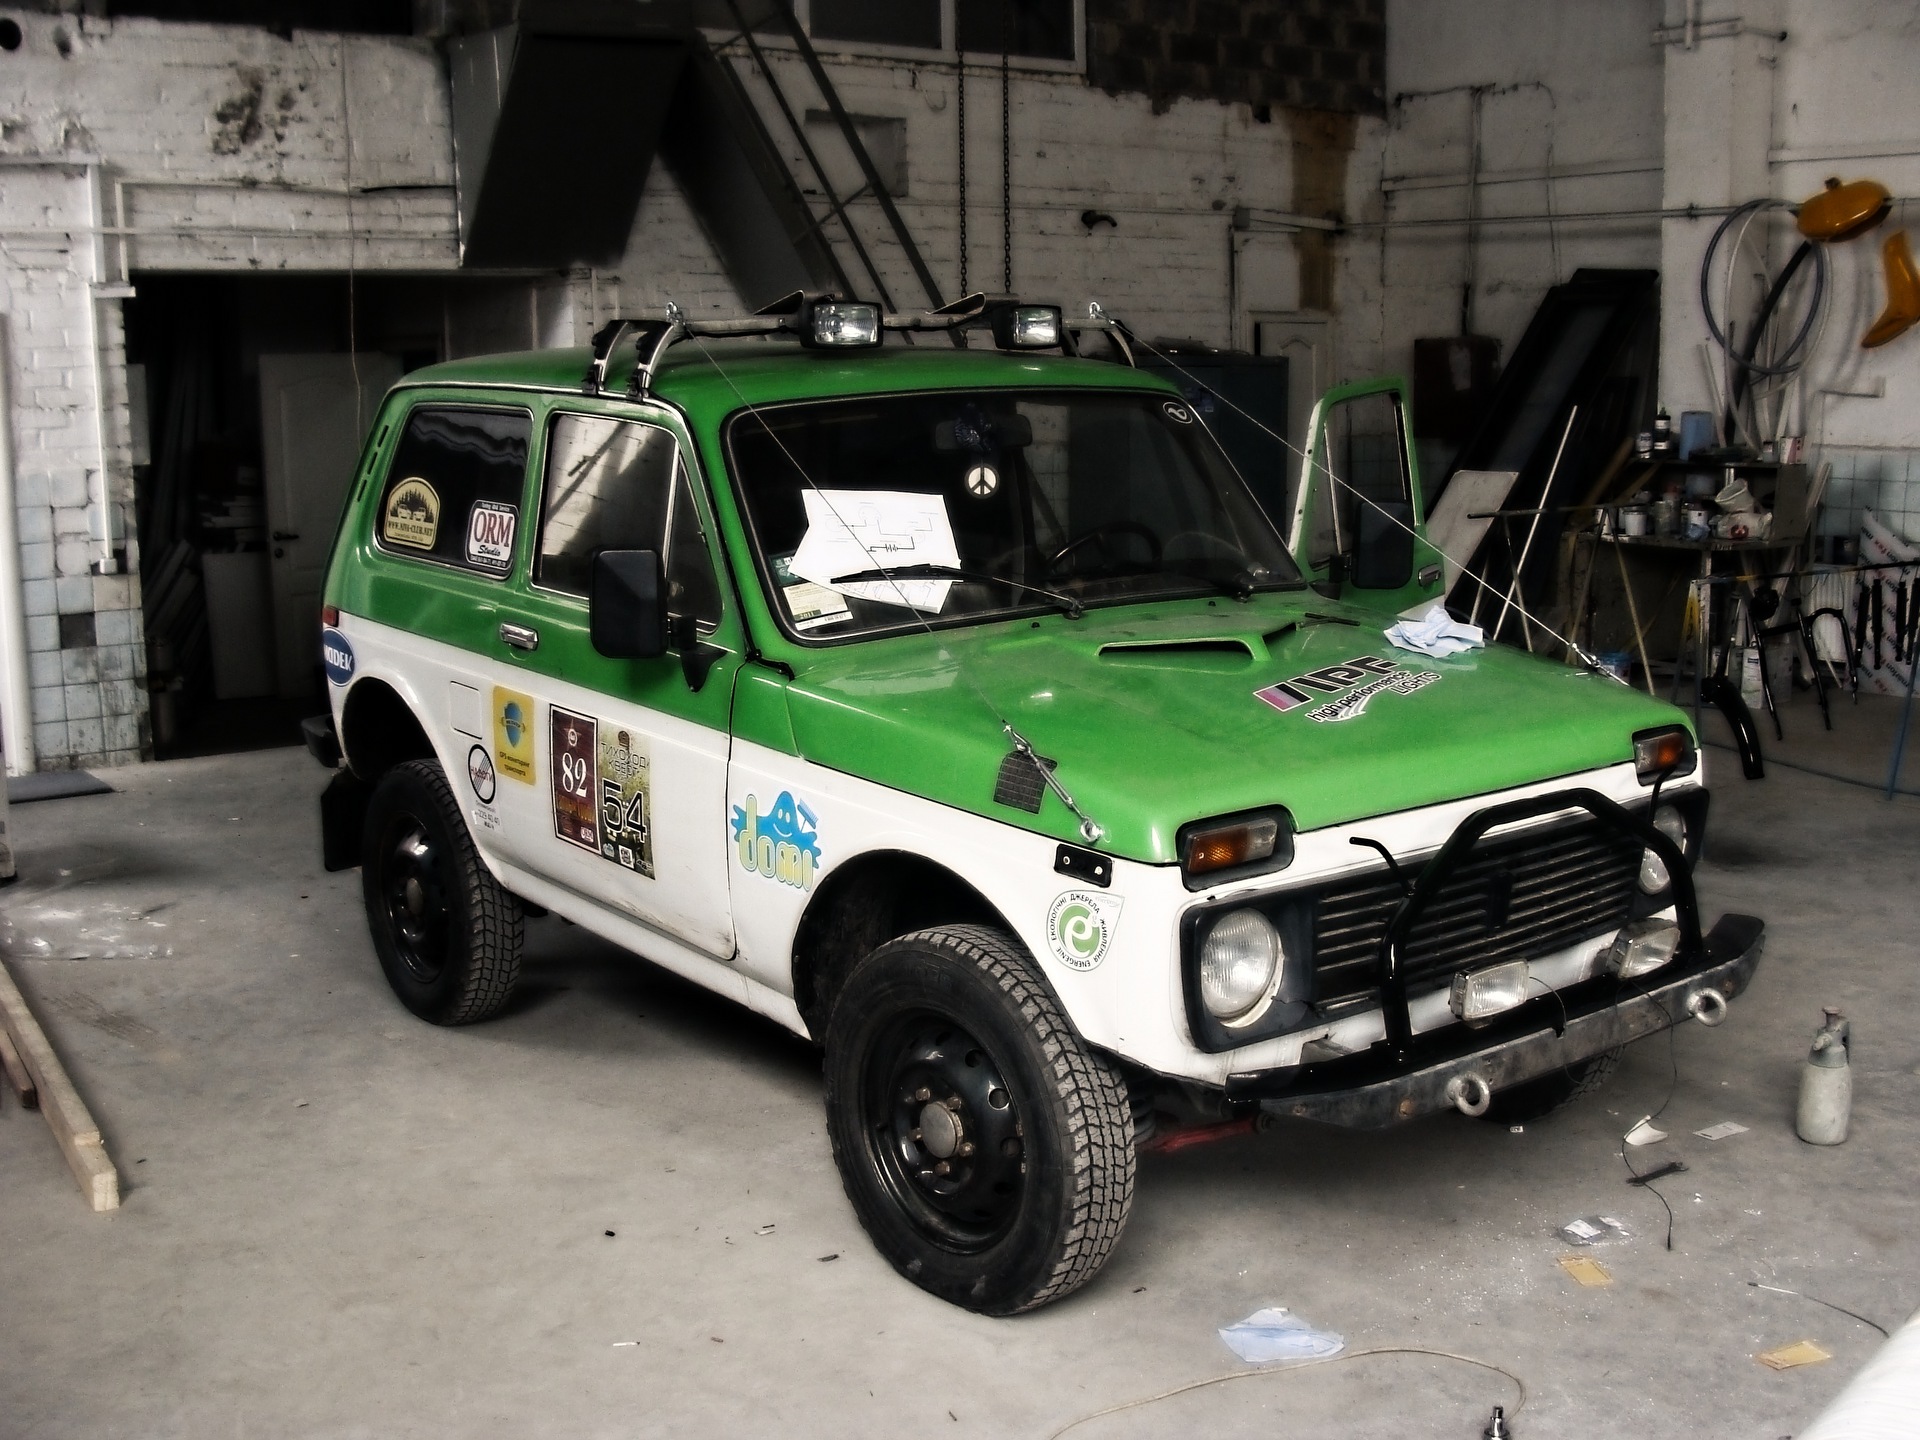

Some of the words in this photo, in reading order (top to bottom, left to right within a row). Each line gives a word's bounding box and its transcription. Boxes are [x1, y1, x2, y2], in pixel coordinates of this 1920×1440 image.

[474, 511, 513, 547] ORM
[477, 544, 501, 556] Studio
[1287, 656, 1400, 693] IPF
[1390, 671, 1442, 694] LIGHTS
[1308, 702, 1339, 720] high
[1339, 671, 1411, 708] performance
[562, 752, 587, 798] 82
[602, 778, 647, 844] 54
[1070, 893, 1100, 914] ДЖЕРЕЛА
[1092, 918, 1108, 963] ЖИВЛЕННЯ
[1056, 947, 1092, 968] ENERGENIE
